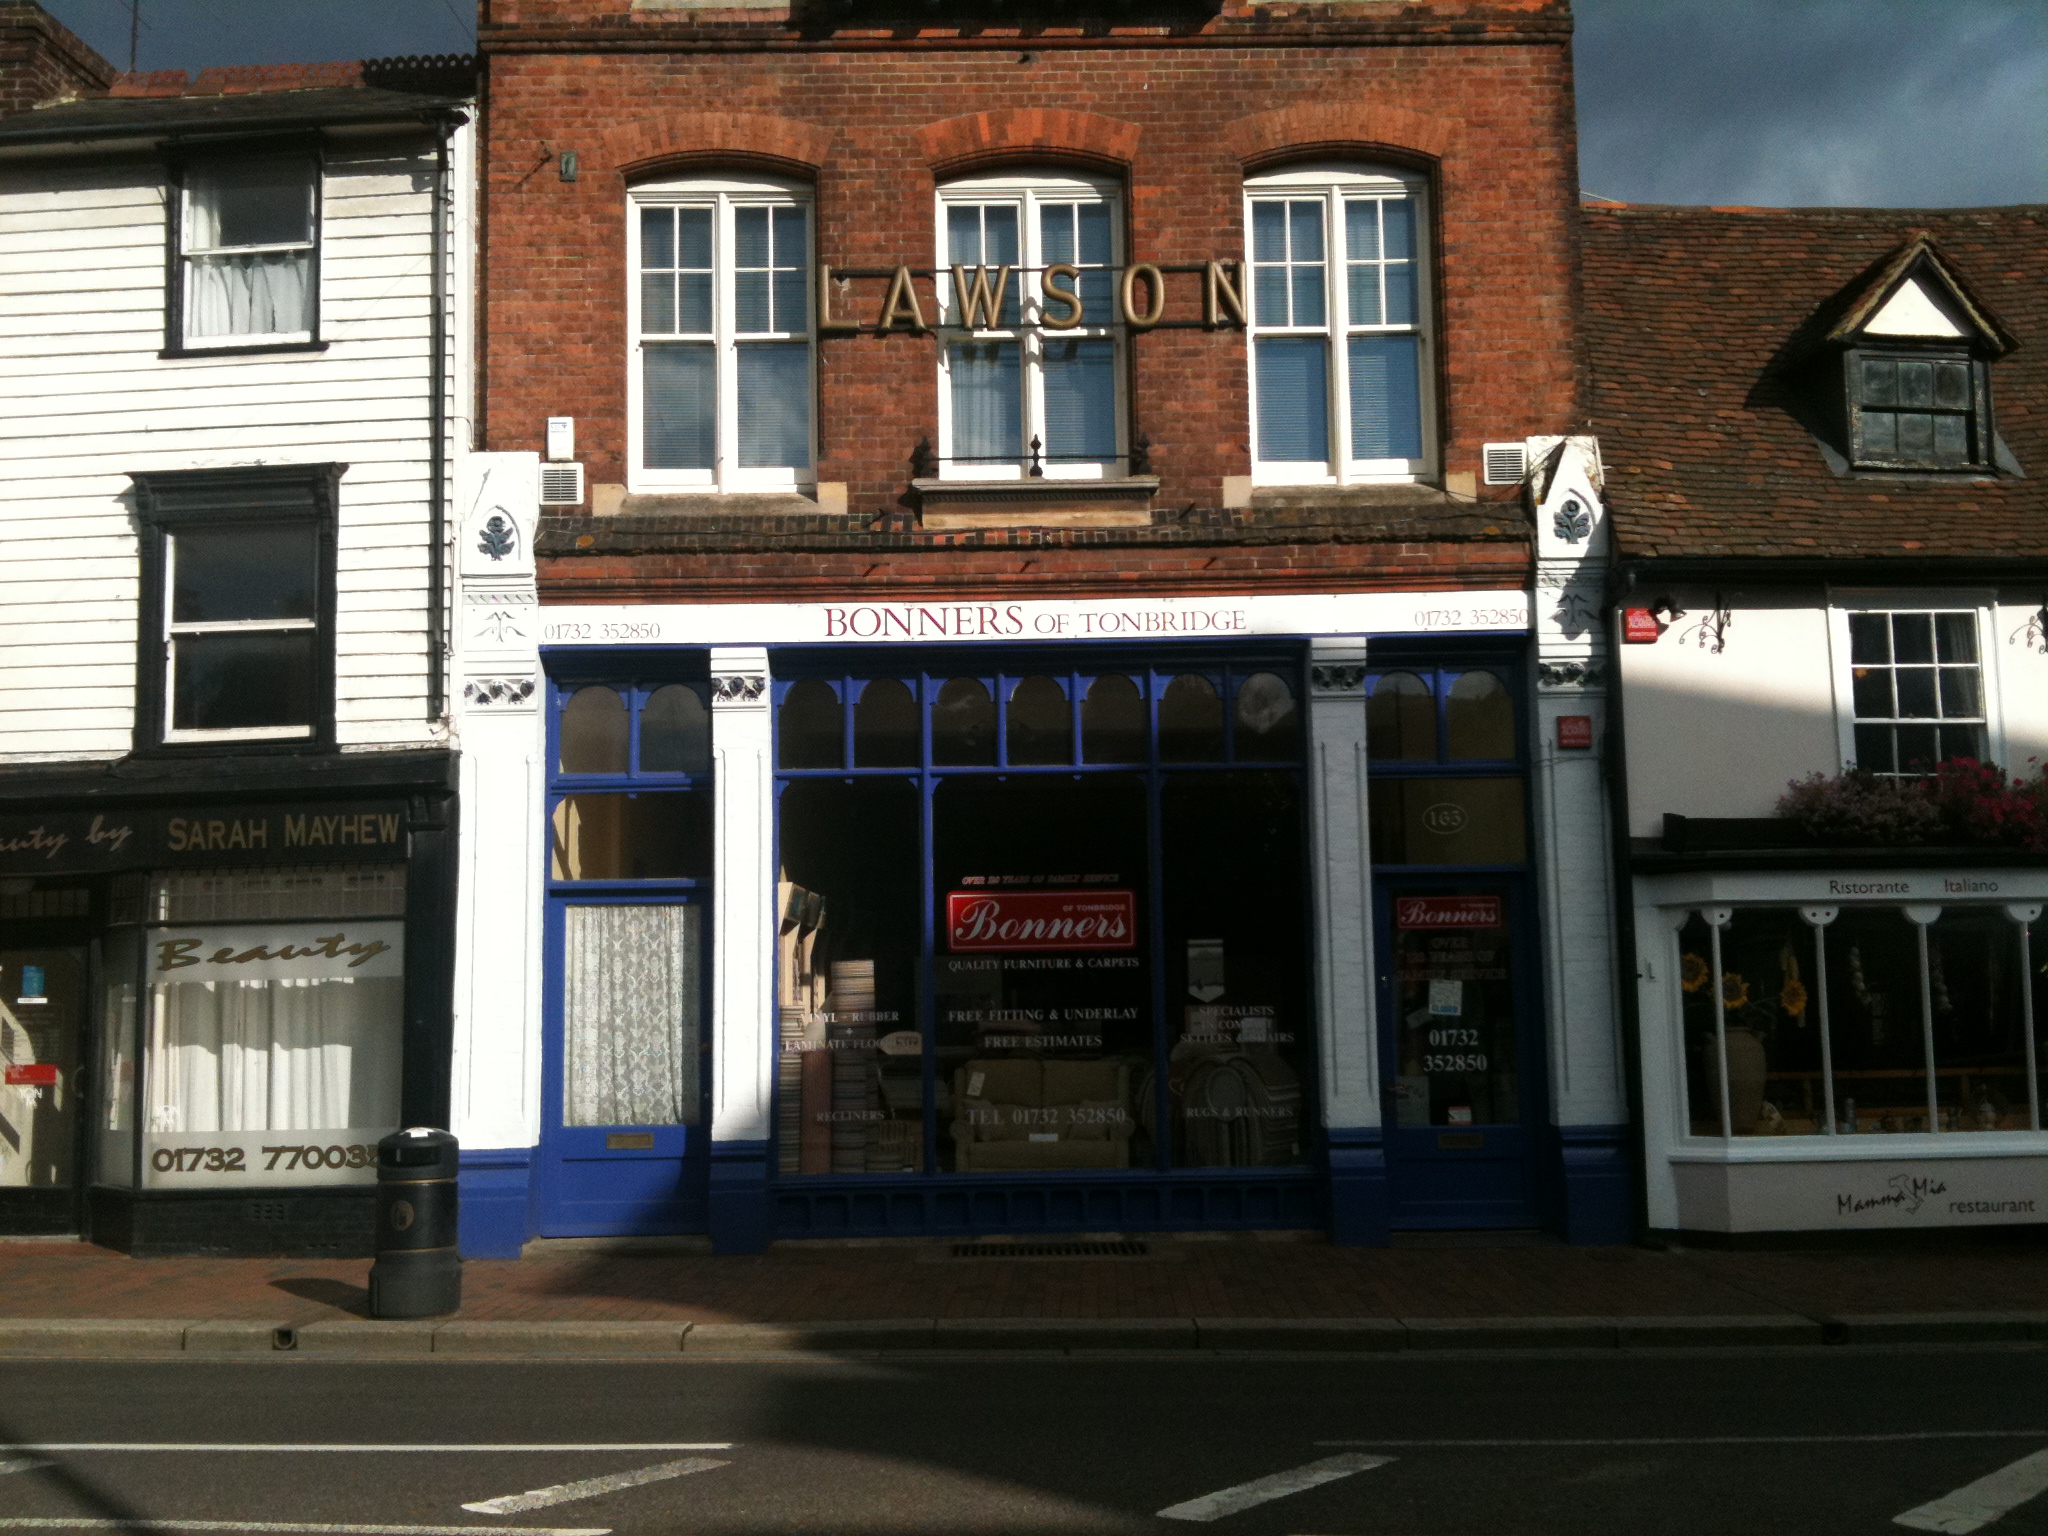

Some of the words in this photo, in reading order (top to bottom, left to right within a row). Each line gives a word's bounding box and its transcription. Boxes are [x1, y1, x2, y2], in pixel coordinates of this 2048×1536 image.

[819, 260, 1248, 330] LAWSON
[823, 605, 1024, 638] BONNERS
[1034, 613, 1071, 634] OF
[1078, 609, 1247, 633] TONBRIDGE
[1414, 609, 1462, 627] 01732
[1469, 607, 1529, 626] 352850
[544, 623, 592, 641] 01732
[600, 622, 661, 640] 352850
[85, 815, 133, 851] by
[168, 817, 267, 851] SARAH
[284, 812, 400, 847] MAYHEW
[1829, 879, 1910, 895] Ristorante
[1945, 878, 1999, 893] Italiano
[1077, 903, 1126, 912] TONBRIDGE
[1401, 900, 1497, 924] Bonners
[955, 899, 1127, 941] Bonners
[156, 933, 391, 971] Beauty
[948, 960, 1000, 971] QUALITY
[1004, 958, 1071, 970] FURNITURE
[1075, 959, 1084, 969] &
[1087, 957, 1139, 969] CARPETS
[852, 1011, 899, 1022] RUBBER
[948, 1009, 983, 1022] FREE
[989, 1009, 1044, 1021] FITTING
[1049, 1009, 1058, 1020] &
[1064, 1007, 1139, 1020] UNDERLAY
[984, 1036, 1018, 1049] FREE
[1025, 1035, 1103, 1048] ESTIMATES
[1428, 1029, 1479, 1047] 01732
[1423, 1053, 1488, 1072] 352850
[816, 1109, 885, 1122] RECLINERS
[966, 1109, 1004, 1125] TEL
[1012, 1108, 1058, 1124] 01732
[1067, 1108, 1127, 1124] 352850
[152, 1147, 246, 1173] 01732
[1837, 1193, 1905, 1216] Mamma
[1912, 1177, 1946, 1199] Mia
[1949, 1199, 2036, 1214] restaurant
